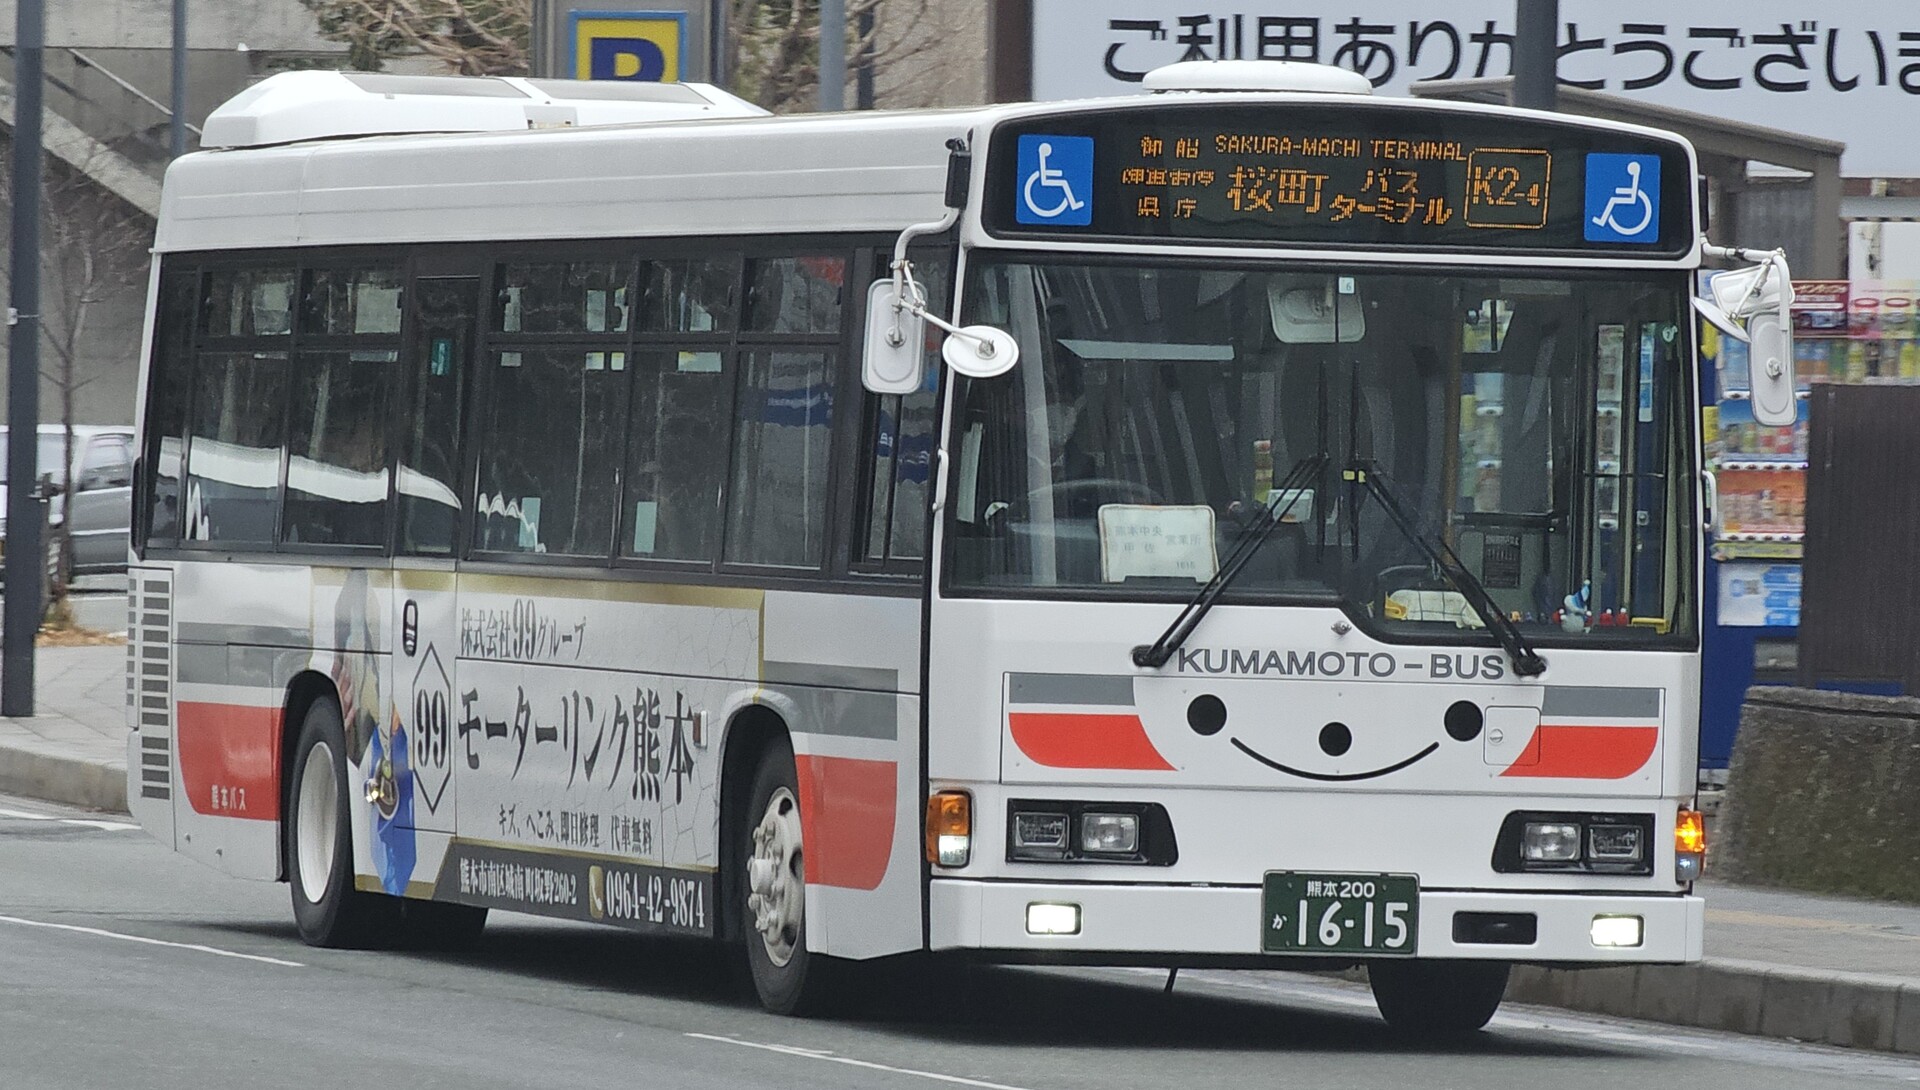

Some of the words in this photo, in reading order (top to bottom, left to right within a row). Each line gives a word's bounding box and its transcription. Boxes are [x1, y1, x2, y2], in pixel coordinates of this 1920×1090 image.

[1215, 135, 1361, 158] SAKURA-MACHI
[1370, 139, 1467, 161] TERMINAL
[1227, 165, 1330, 214] 桜町
[1328, 194, 1453, 225] ターミナル
[1472, 165, 1541, 207] K2-4
[460, 598, 587, 661] 株式会社99グループ
[415, 688, 446, 769] 99
[457, 685, 695, 805] モーターリンク熊本
[605, 870, 705, 929] 0964-42-9874
[1272, 914, 1288, 930] か
[1298, 899, 1409, 948] 16-15
